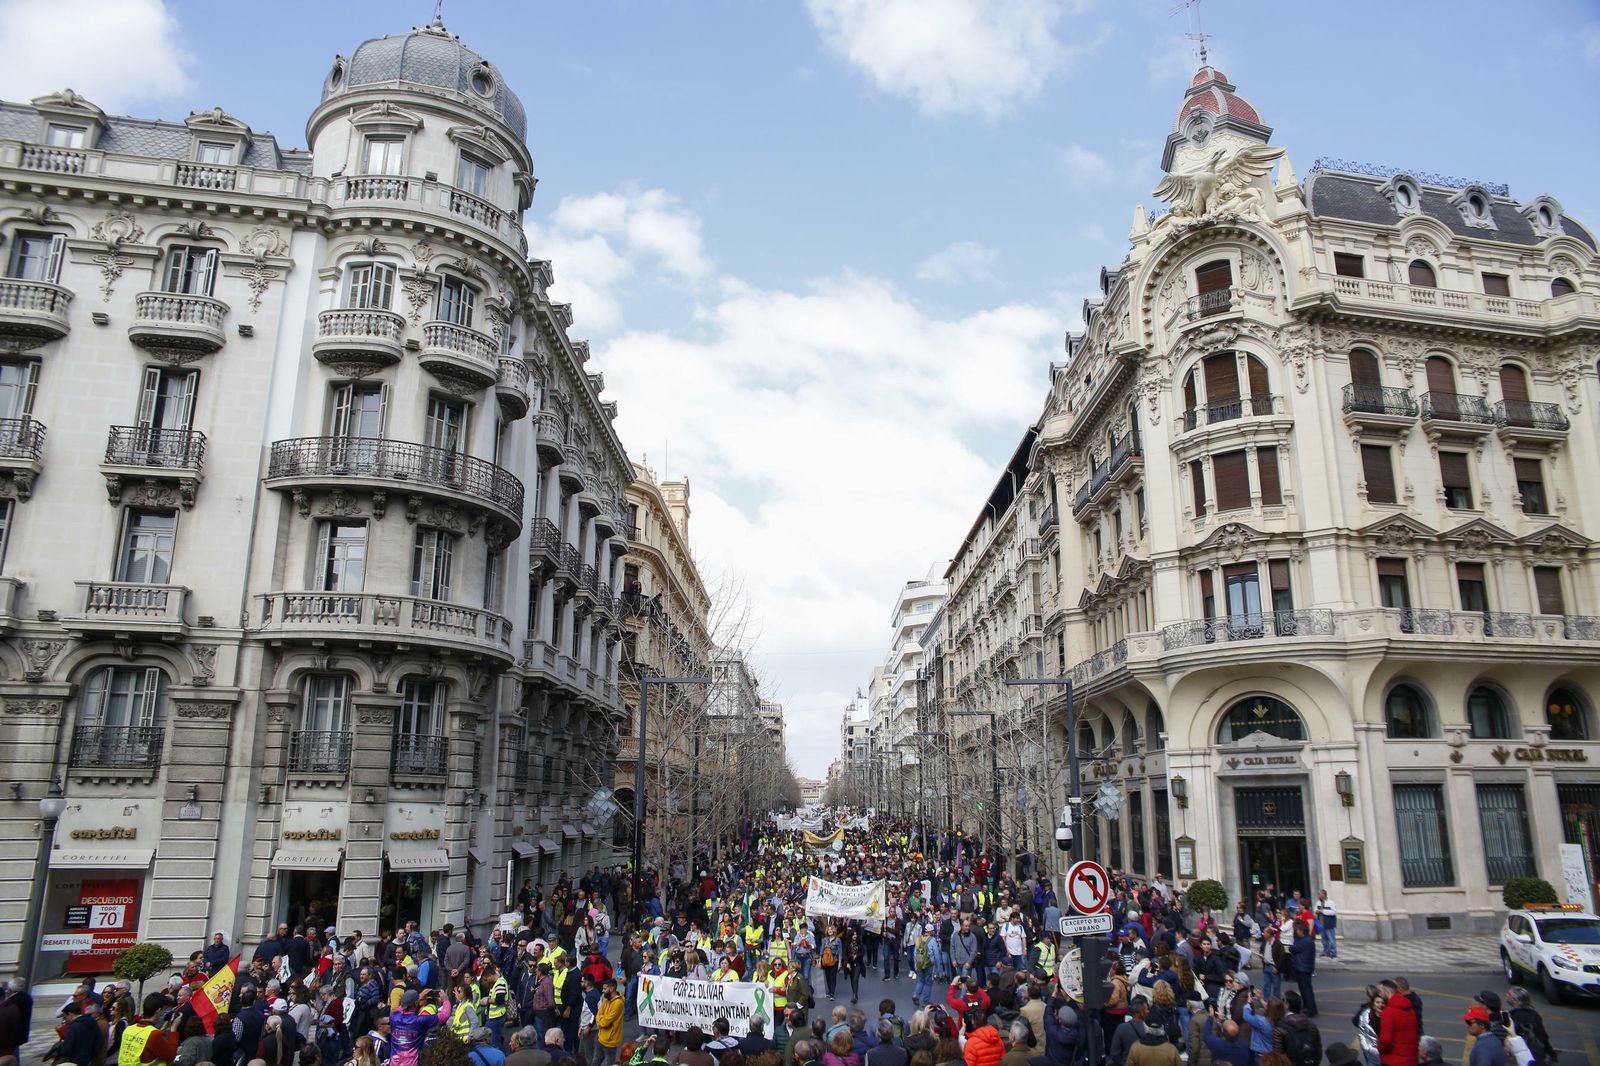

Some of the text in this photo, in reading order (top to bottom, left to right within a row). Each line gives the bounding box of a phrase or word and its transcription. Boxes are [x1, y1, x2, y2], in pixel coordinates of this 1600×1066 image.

[1267, 756, 1296, 764] RURAL
[1546, 749, 1588, 762] RURAL
[70, 826, 137, 840] cortefiel
[282, 828, 341, 840] cortefiel
[821, 882, 834, 890] LOS
[82, 896, 134, 904] DESCUENTOS
[673, 982, 724, 1000] POR EL OLIVAR
[655, 1000, 751, 1019] TRADICIONAL Y ALTA MONTAÑA
[645, 1018, 684, 1028] VILLANUEVA
